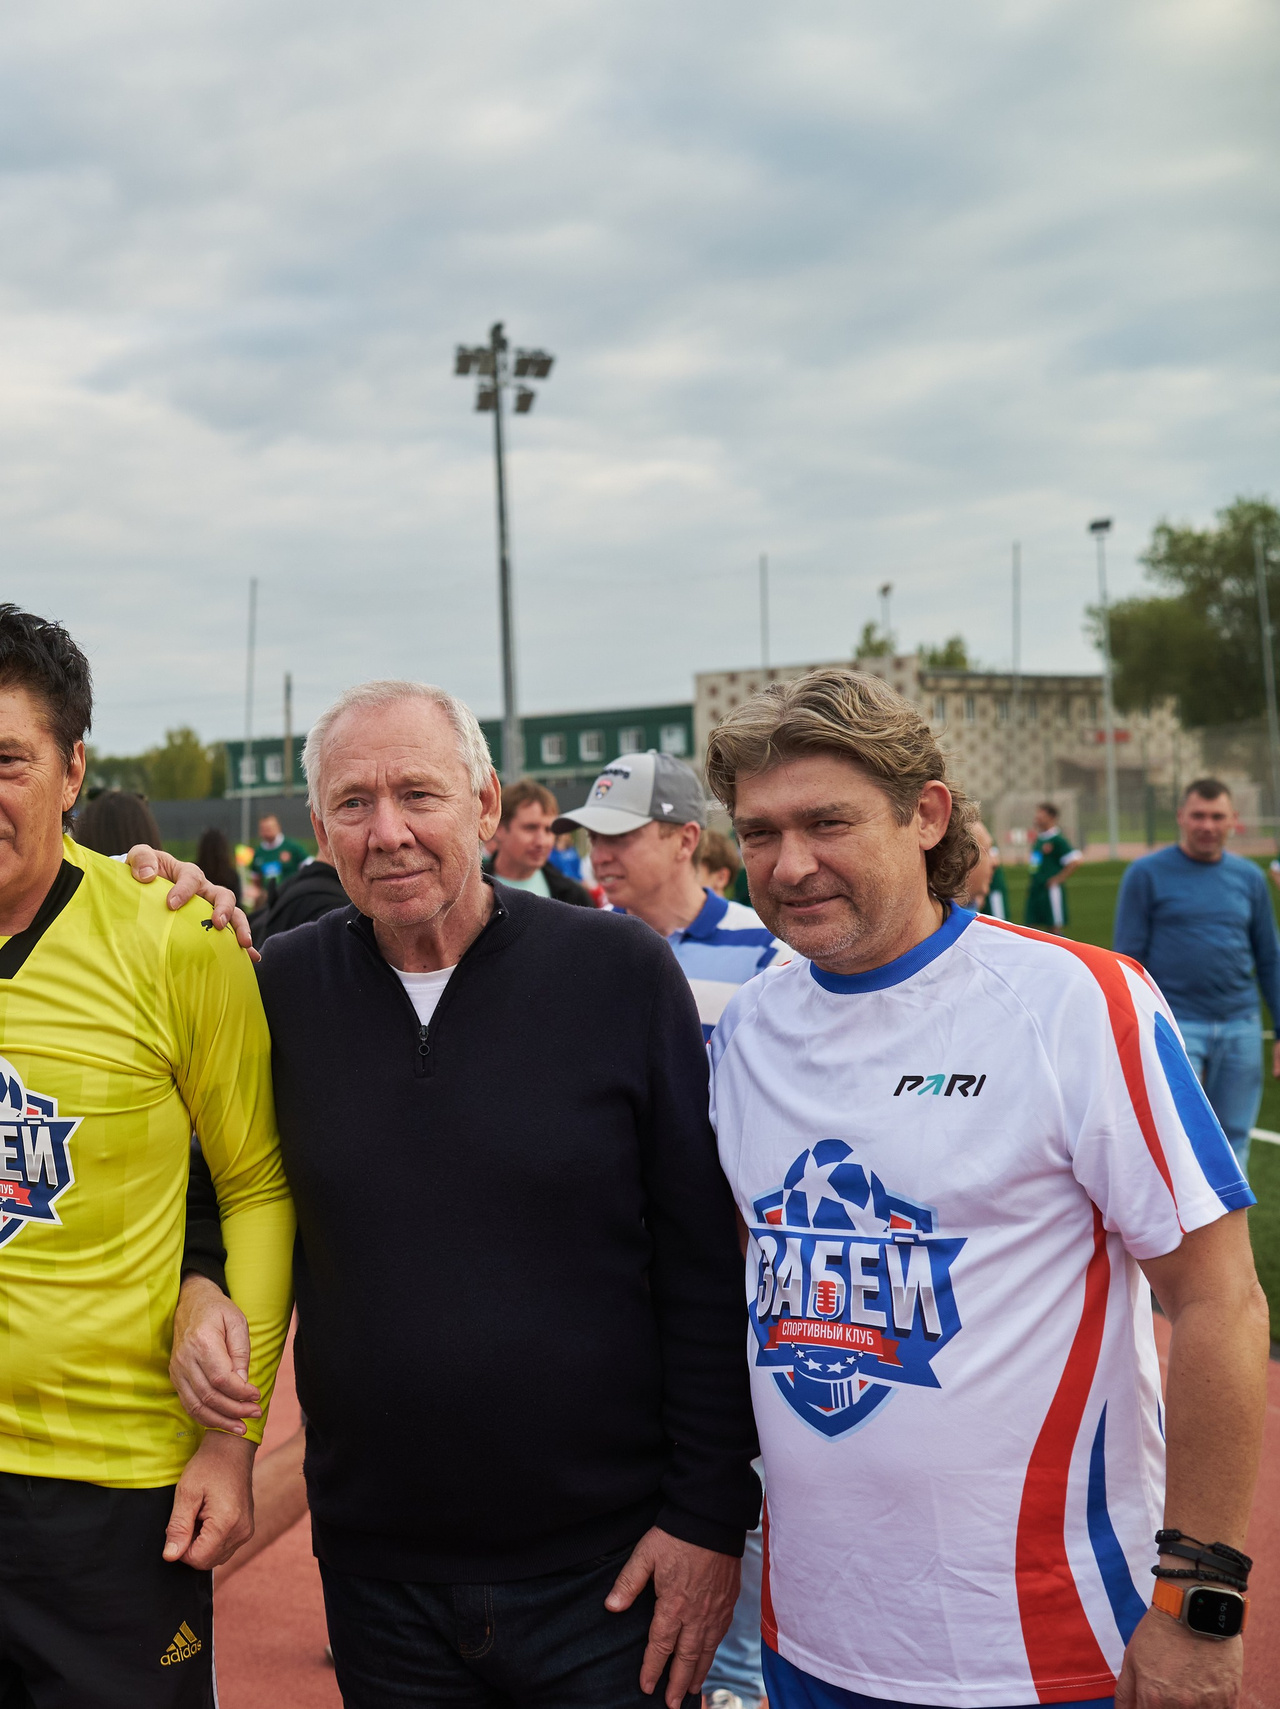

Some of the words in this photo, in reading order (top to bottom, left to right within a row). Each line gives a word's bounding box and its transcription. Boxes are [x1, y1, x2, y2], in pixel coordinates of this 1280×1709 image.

[893, 1074, 987, 1097] PARI
[756, 1236, 944, 1339] ЗАБЕЙ
[782, 1321, 843, 1341] СПОРТИВНЫЙ
[845, 1327, 874, 1346] КЛУБ
[1218, 1601, 1228, 1629] 16:57
[160, 1640, 202, 1666] adidas
